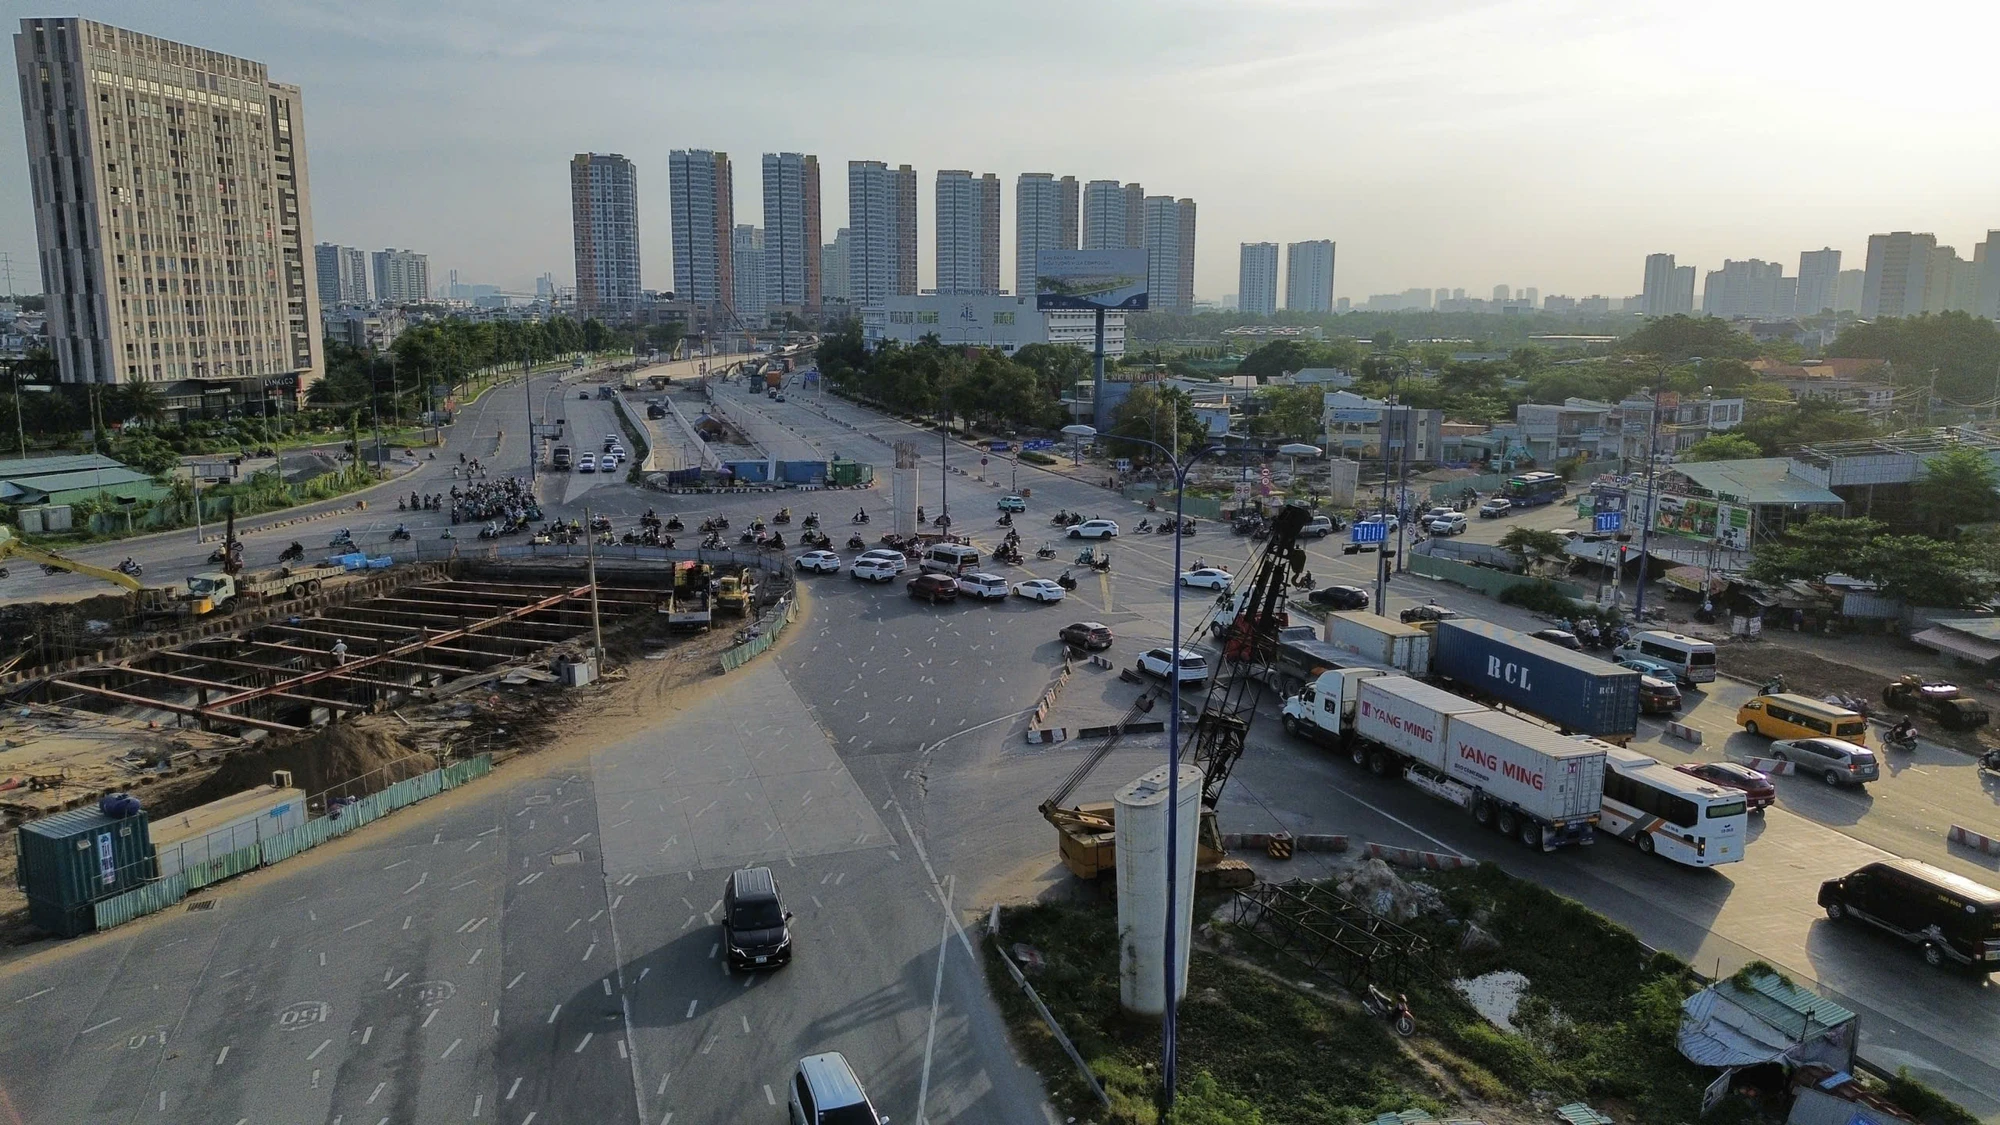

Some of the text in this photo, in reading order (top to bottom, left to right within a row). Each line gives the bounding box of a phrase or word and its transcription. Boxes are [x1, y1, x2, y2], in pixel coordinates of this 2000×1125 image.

[1487, 654, 1532, 691] RCL
[1599, 686, 1615, 694] RCL
[1373, 707, 1433, 743] YANG MING
[1458, 741, 1497, 772] YANG
[1502, 760, 1544, 791] MING
